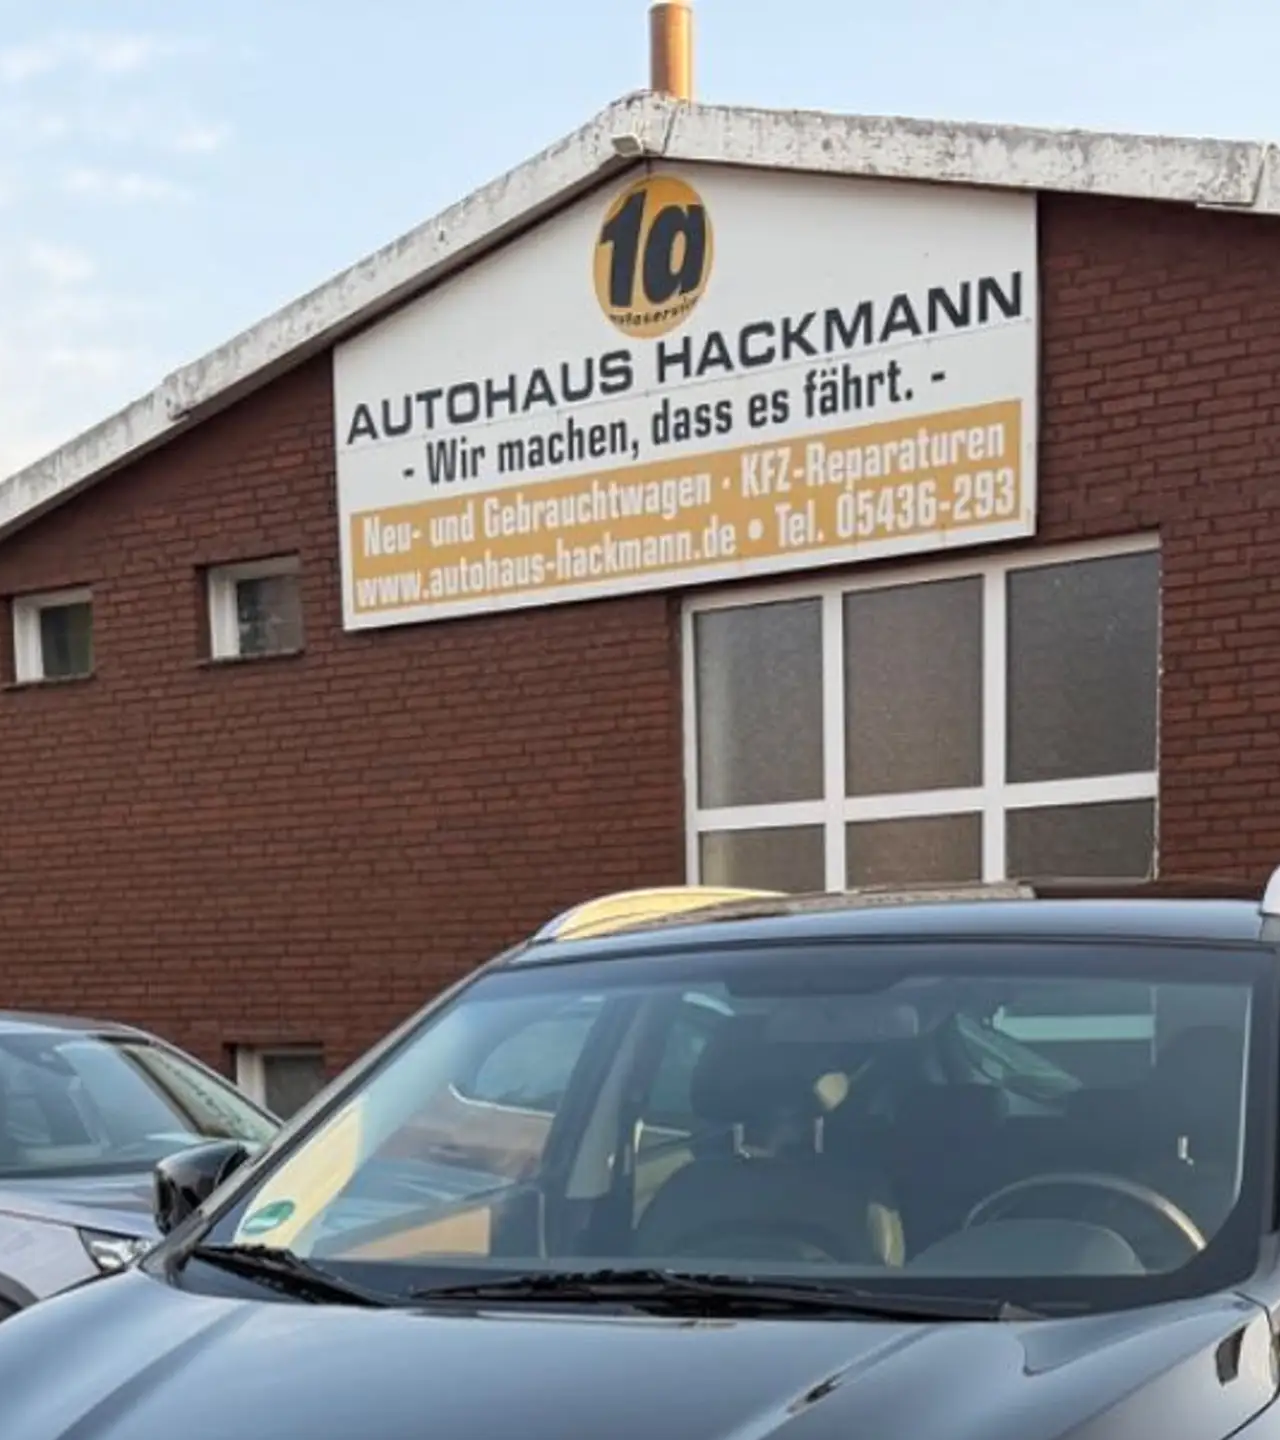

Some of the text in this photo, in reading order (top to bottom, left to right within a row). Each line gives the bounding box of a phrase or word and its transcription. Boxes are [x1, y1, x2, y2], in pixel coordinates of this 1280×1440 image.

[600, 189, 706, 308] 1a
[347, 271, 1022, 445] AUTOHAUS HACKMANN
[426, 436, 485, 485] Wir
[498, 416, 639, 474] machen,
[652, 399, 732, 446] dass
[748, 386, 790, 428] es
[804, 360, 912, 418] fährt.
[356, 467, 1014, 607] www.autohaus-hackmann.de Tel. 05436-293
[362, 423, 1004, 557] Neu- und Gebrauchtwagen KFZ-Reparaturen
